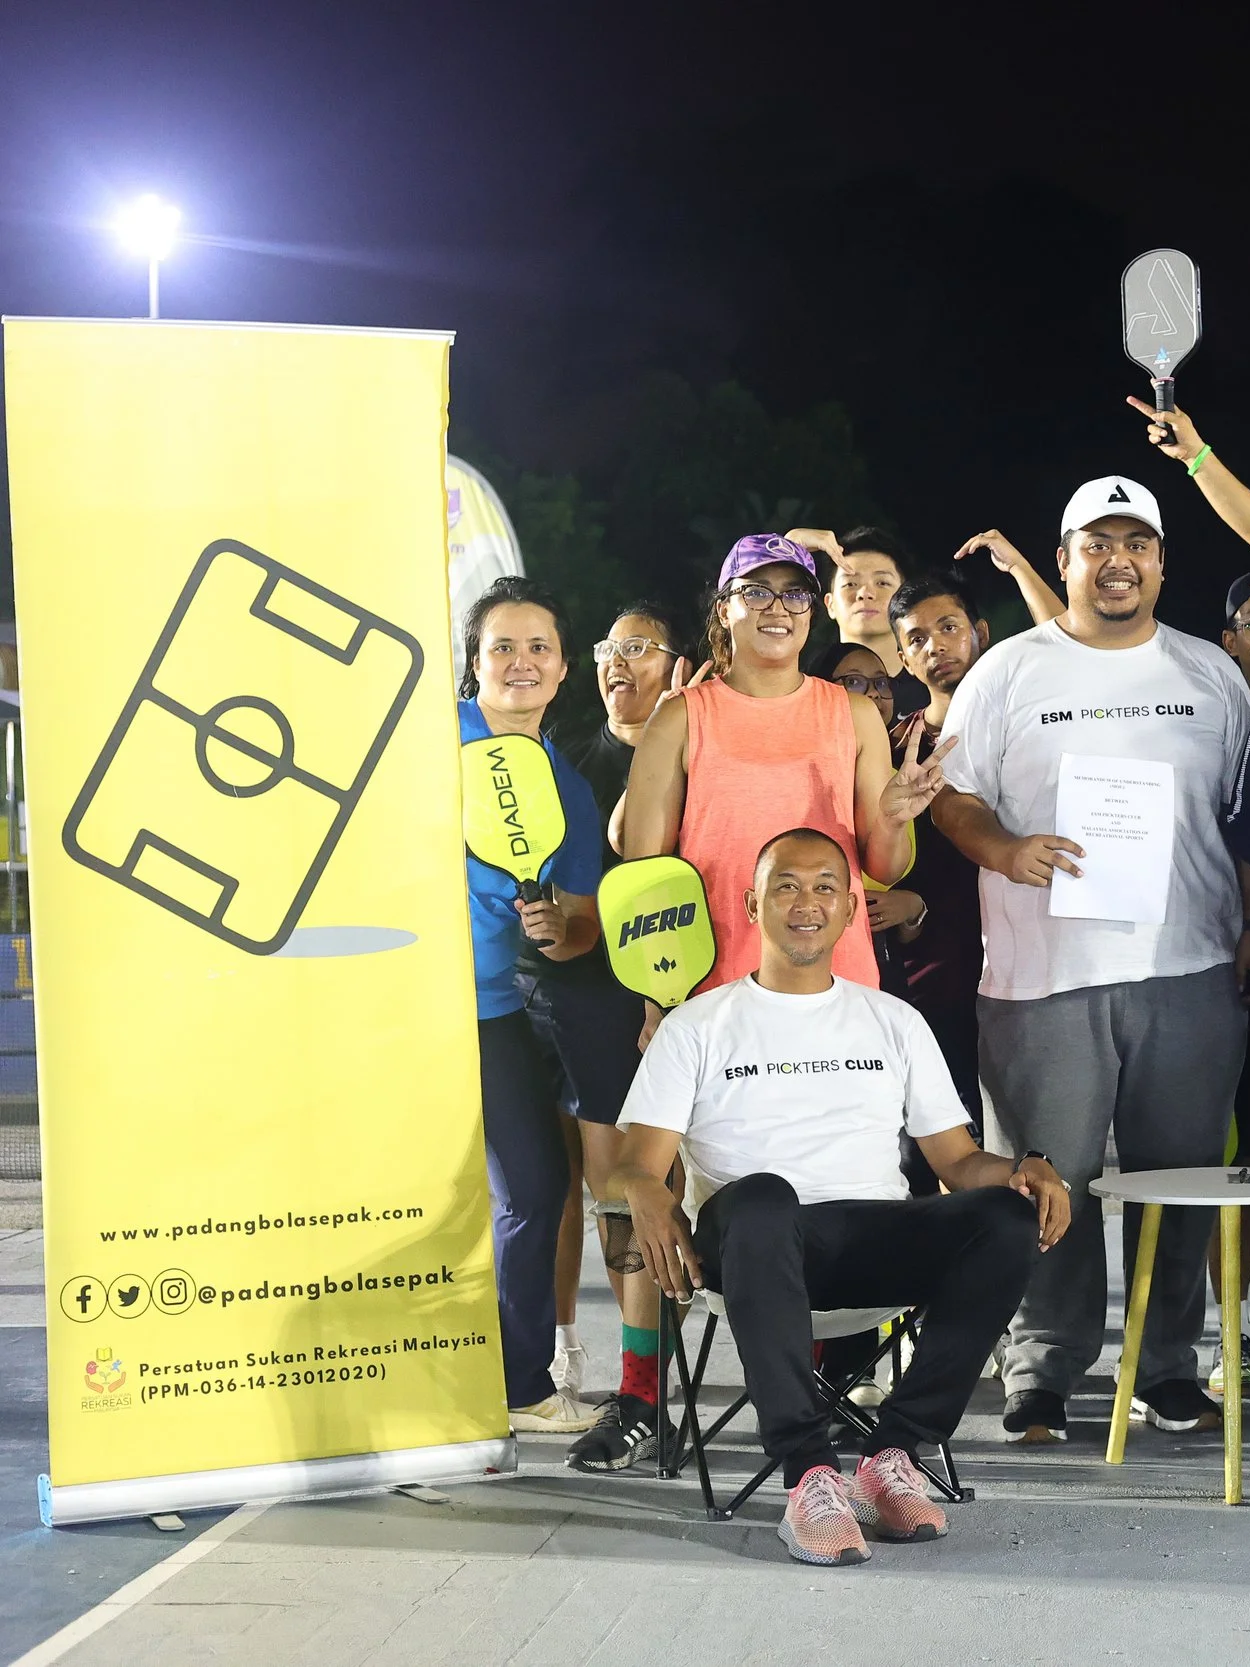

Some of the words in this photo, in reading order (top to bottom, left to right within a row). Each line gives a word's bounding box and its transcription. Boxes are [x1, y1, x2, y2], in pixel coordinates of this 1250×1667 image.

[1041, 710, 1072, 724] ESM
[1081, 706, 1150, 719] PICKTERS
[1155, 704, 1194, 716] CLUB
[486, 746, 530, 856] DIADEM
[618, 902, 696, 948] HERO
[725, 1064, 758, 1080] ESM
[767, 1060, 840, 1074] PICKTERS
[845, 1060, 884, 1070] CLUB
[100, 1206, 423, 1242] www.padangbolasepak.com
[198, 1265, 455, 1308] @padangbolasepak
[140, 1359, 238, 1377] Persatuan
[246, 1351, 306, 1366] Sukan
[314, 1340, 397, 1360] Rekreasi
[403, 1332, 486, 1351] Malaysia
[81, 1398, 132, 1410] REKREASI
[141, 1364, 386, 1404] (PPM-036-14-23012020)
